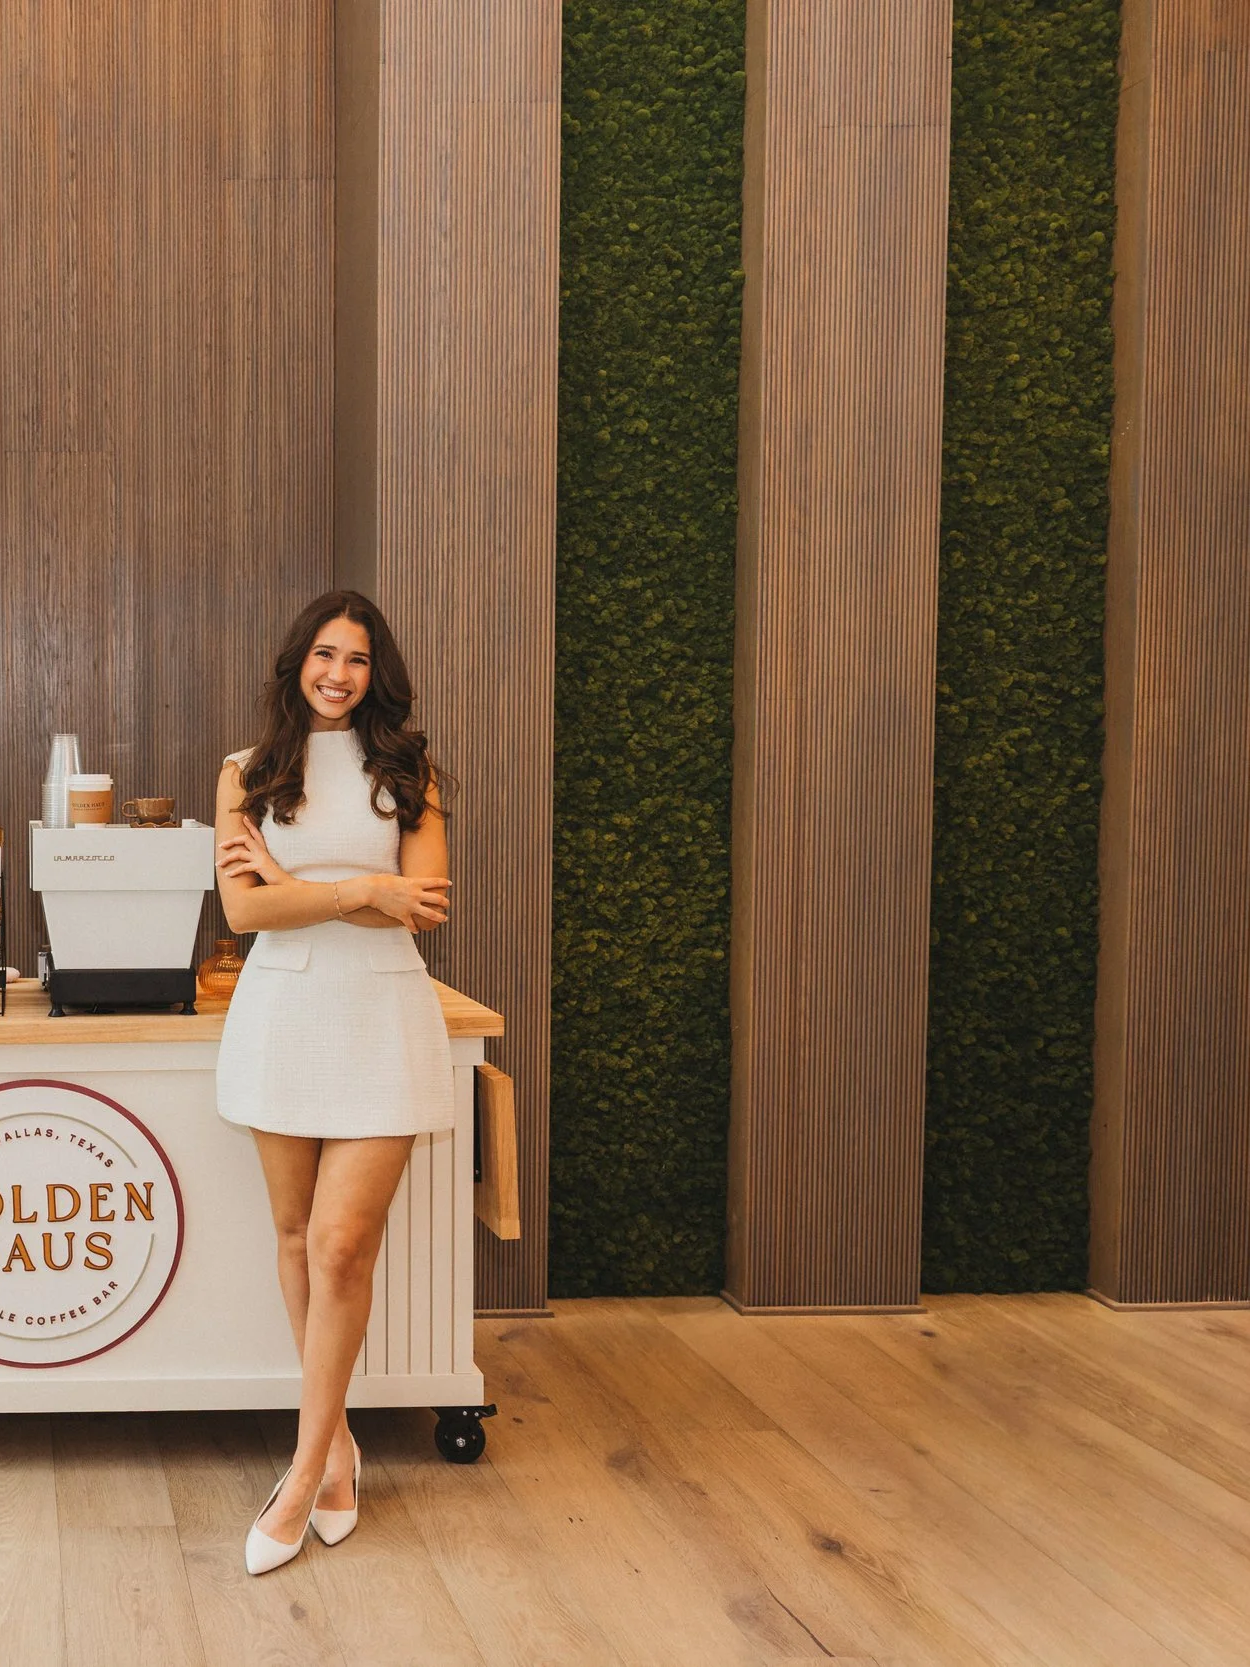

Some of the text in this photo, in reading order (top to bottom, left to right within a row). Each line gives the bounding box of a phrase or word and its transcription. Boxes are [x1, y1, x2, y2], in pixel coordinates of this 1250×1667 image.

[69, 1132, 114, 1168] TEXAS
[25, 1304, 88, 1326] COFFEE
[93, 1280, 119, 1306] BAR
